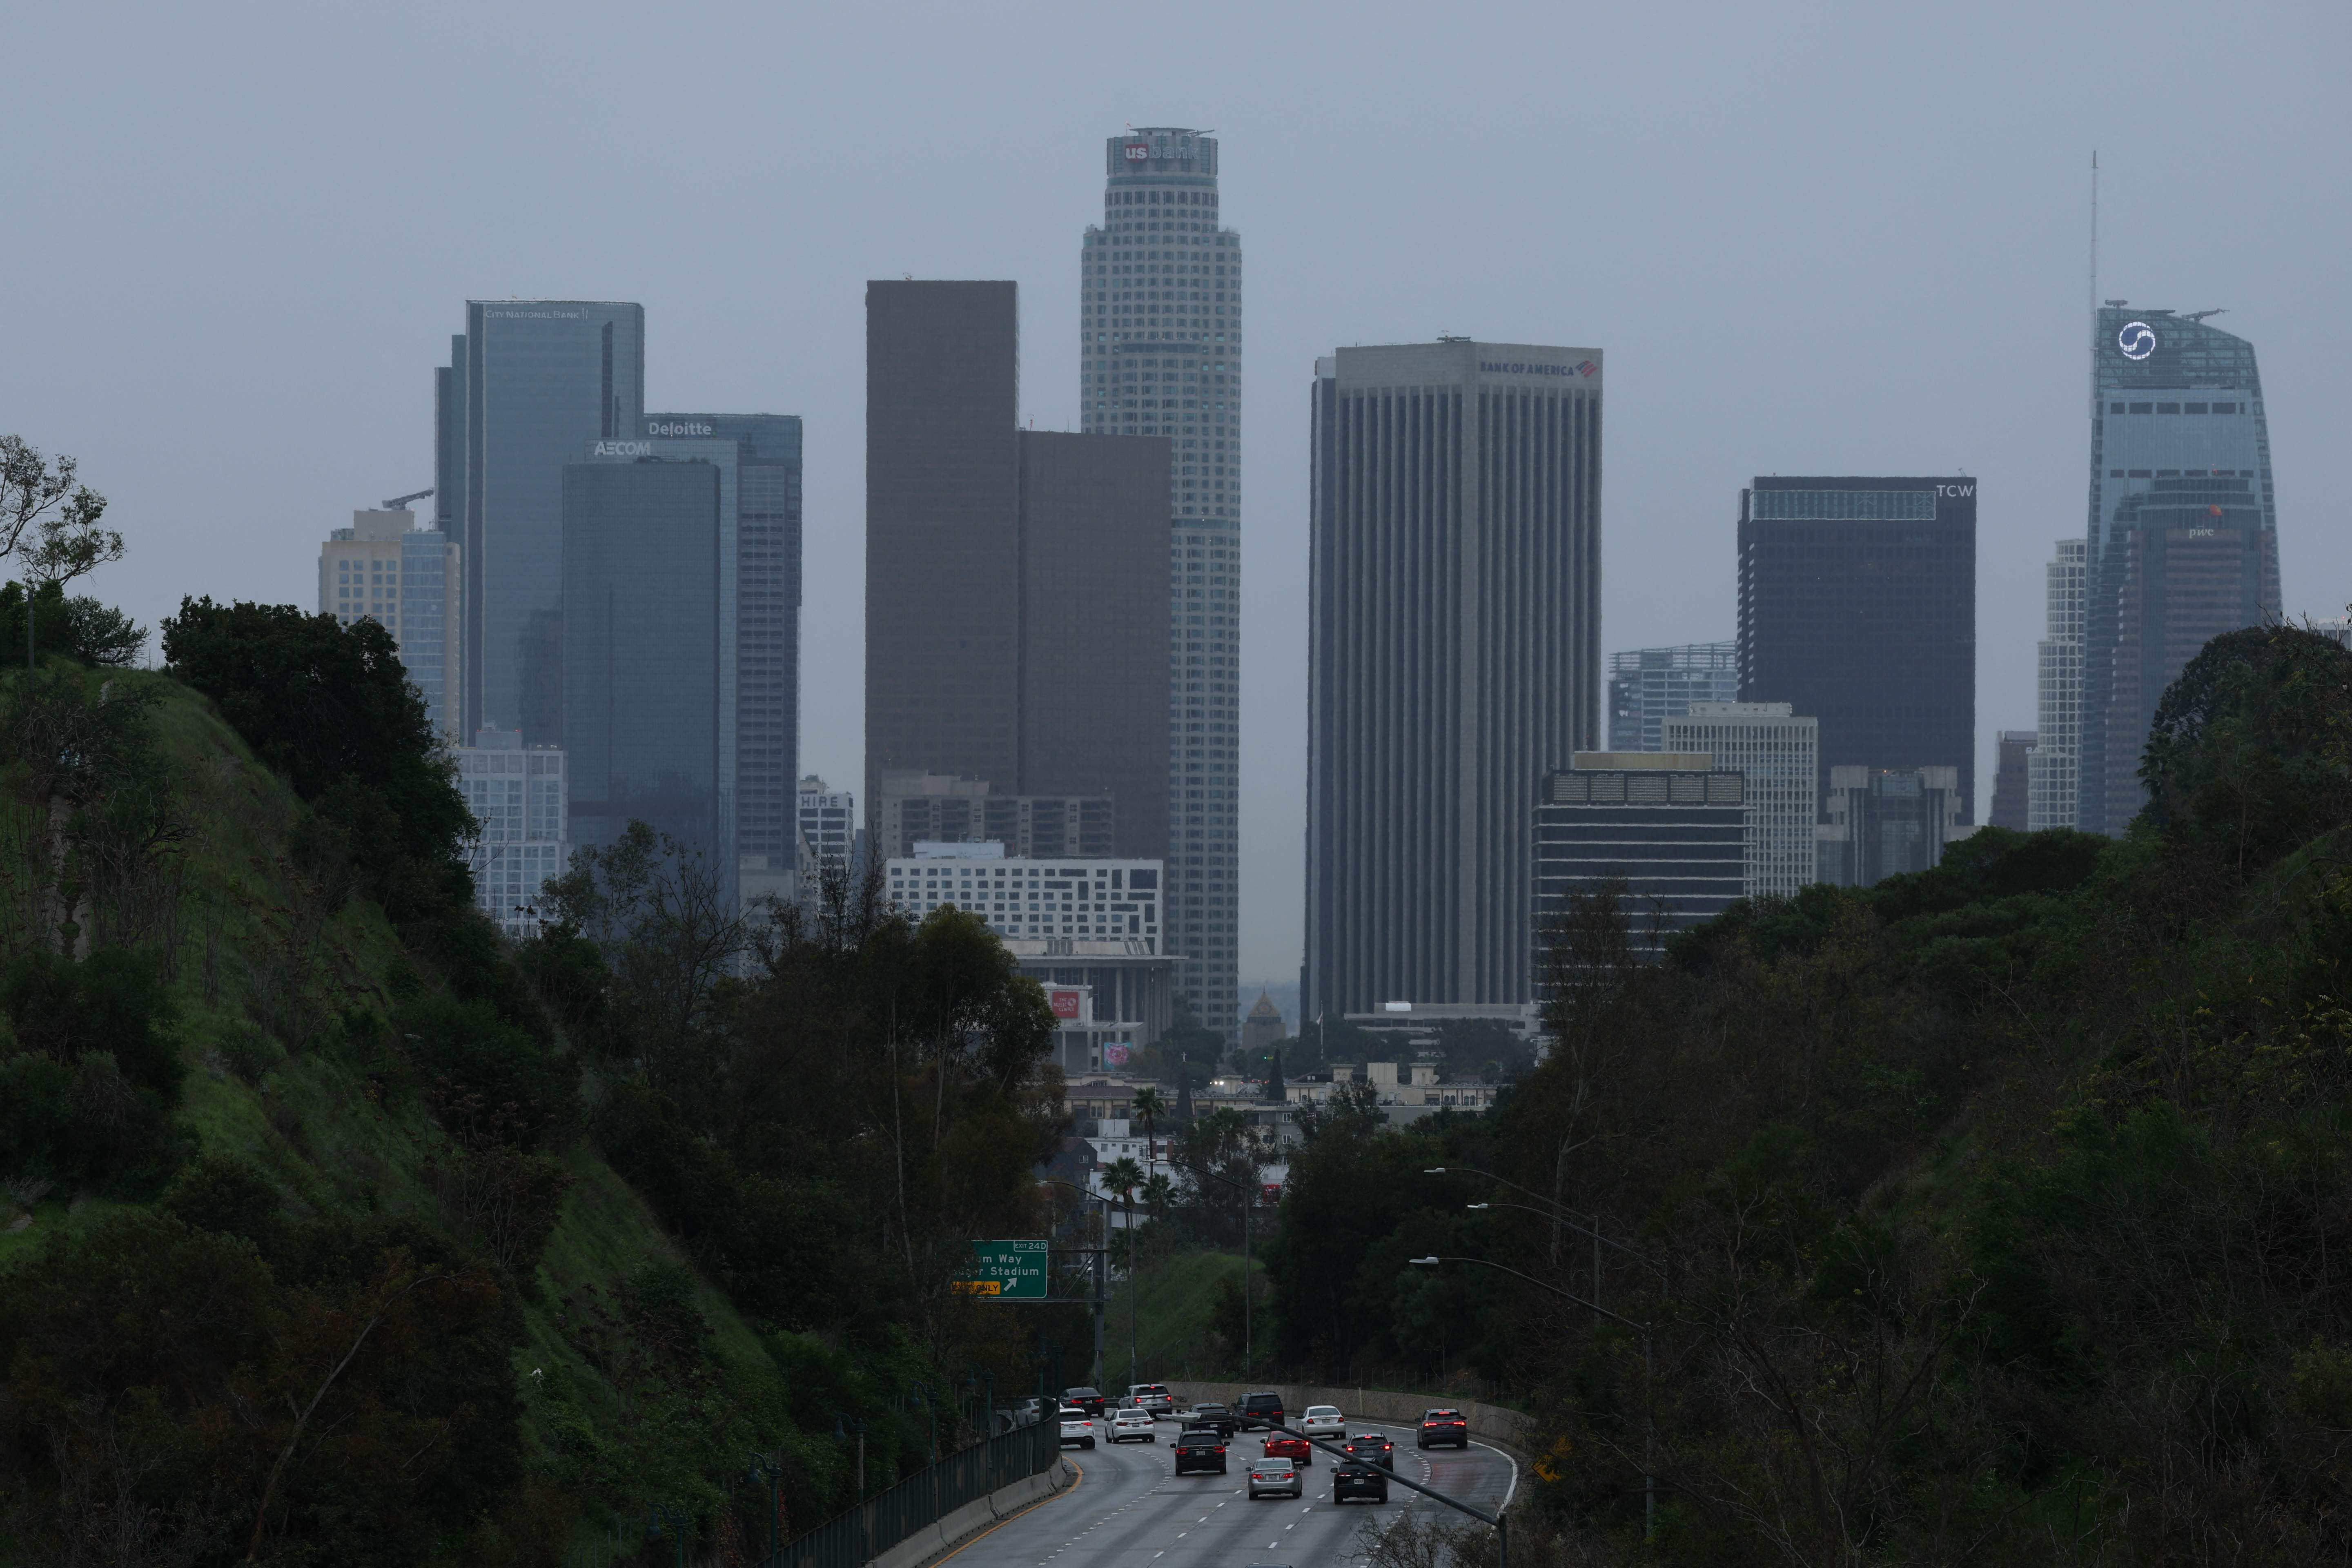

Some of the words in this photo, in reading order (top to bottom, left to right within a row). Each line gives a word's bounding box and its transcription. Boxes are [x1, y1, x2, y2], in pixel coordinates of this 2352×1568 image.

[554, 310, 579, 318] BANK
[1480, 362, 1510, 373] BANK
[1511, 363, 1525, 374] OF
[1527, 364, 1574, 376] AMERICA
[594, 441, 650, 456] AECOM
[1936, 485, 1973, 497] TCW
[2189, 529, 2214, 539] pwc
[999, 1254, 1022, 1265] Way
[991, 1267, 1039, 1276] Stadium
